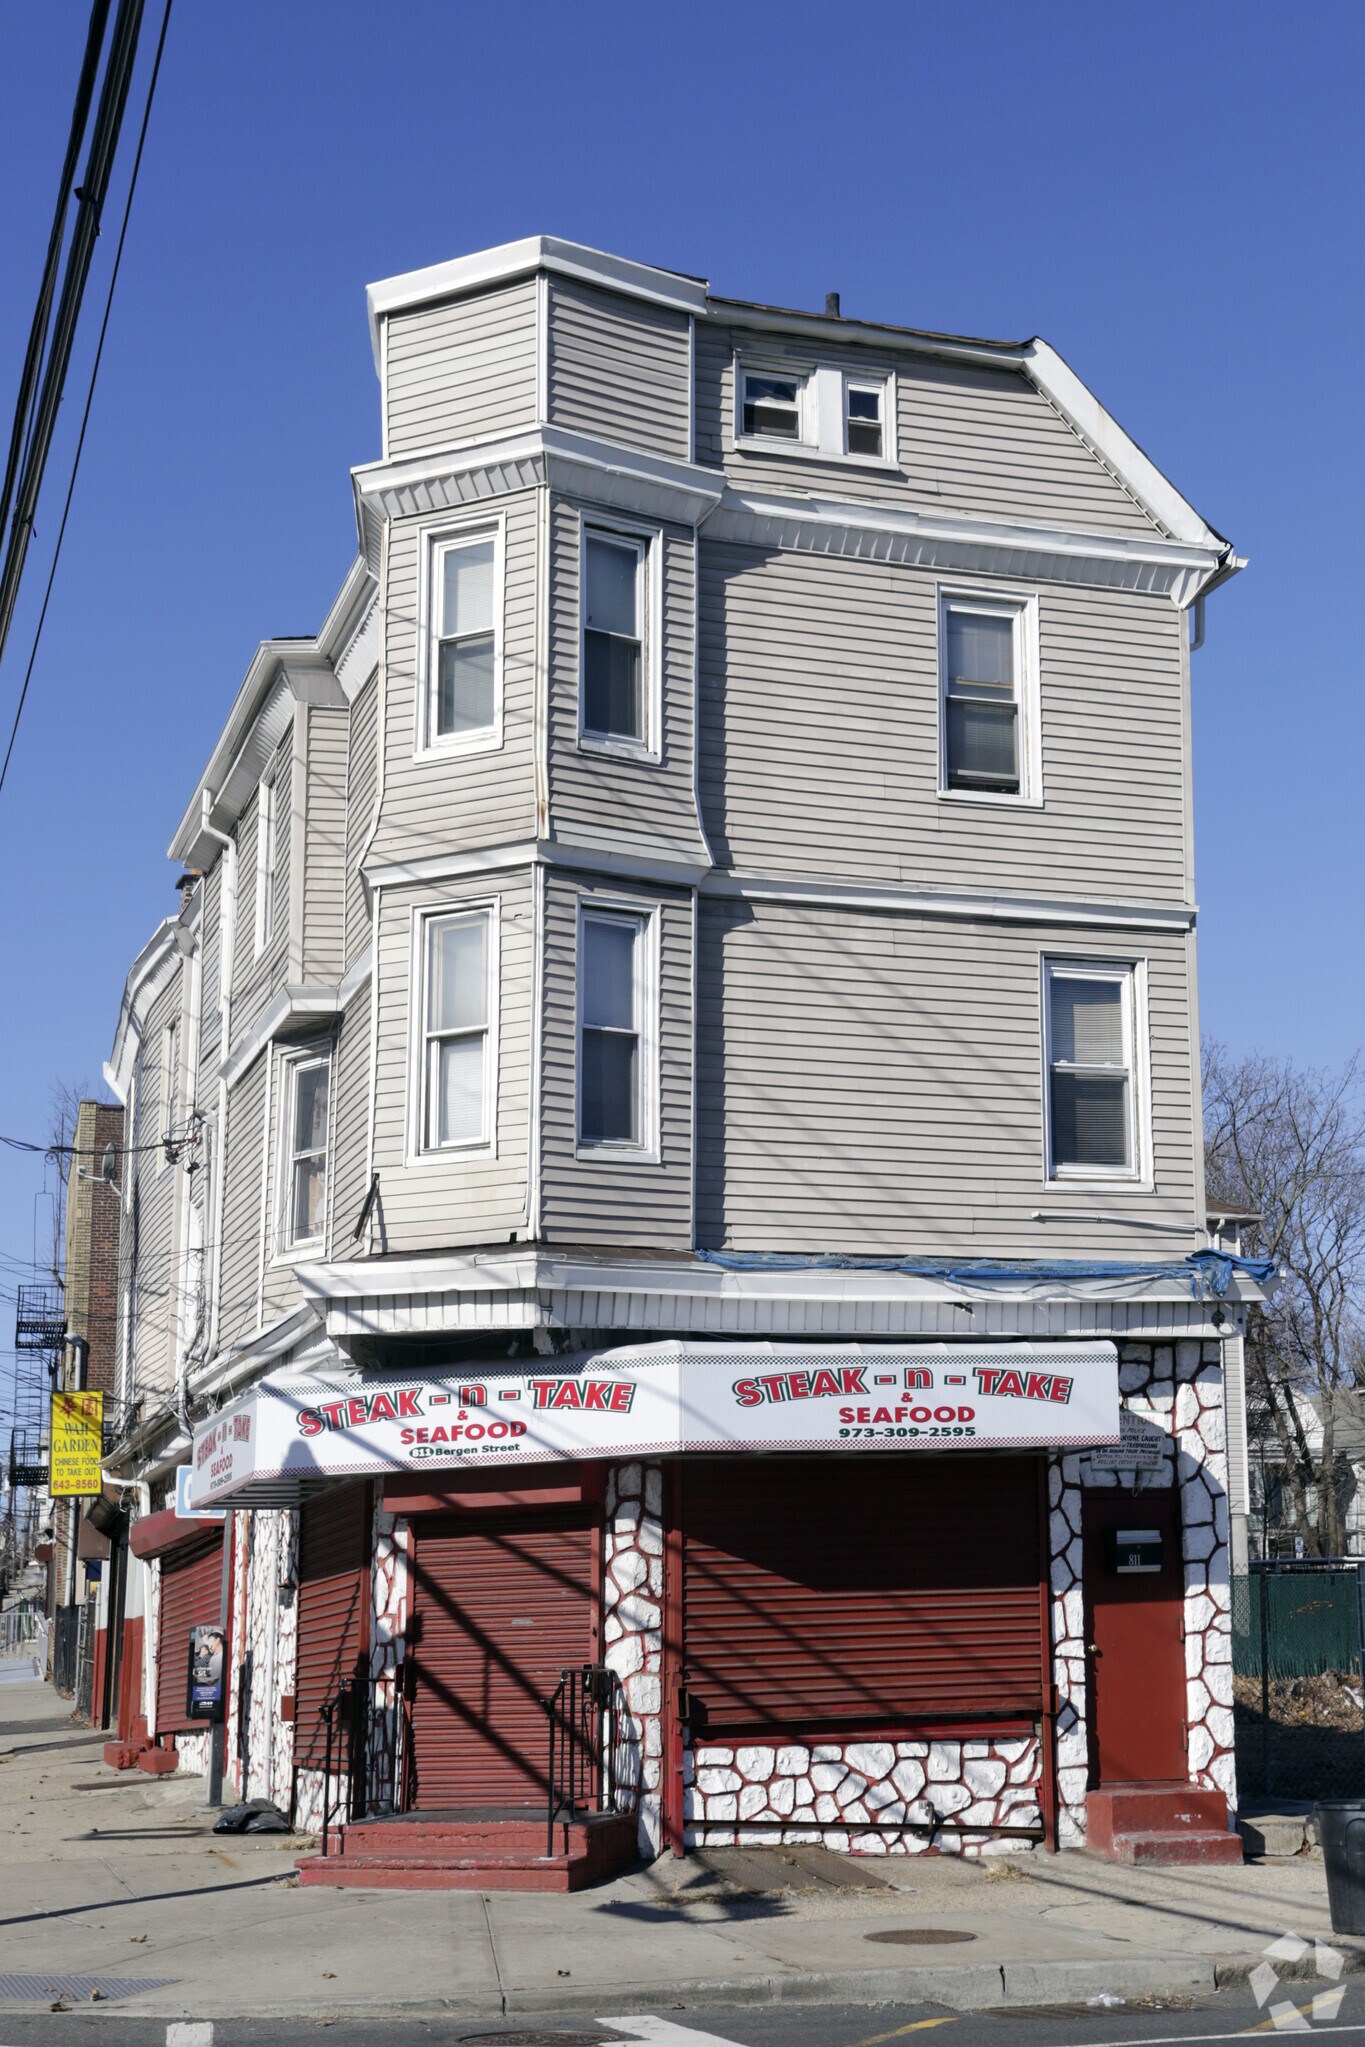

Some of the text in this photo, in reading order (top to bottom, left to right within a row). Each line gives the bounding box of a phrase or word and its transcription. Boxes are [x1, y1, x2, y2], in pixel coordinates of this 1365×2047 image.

[732, 1367, 871, 1407] STEAK
[972, 1367, 1074, 1404] TAKE
[901, 1392, 913, 1403] &
[296, 1387, 425, 1437] STEAK
[528, 1379, 637, 1413] TAKE
[457, 1410, 468, 1421] &
[839, 1406, 975, 1424] SEAFOOD
[65, 1422, 88, 1435] WAH
[400, 1421, 527, 1445] SEAFOOD
[839, 1427, 976, 1438] 973-309-2595
[54, 1438, 99, 1452] GARDEN
[411, 1443, 520, 1458] 811 Bergen Street
[55, 1457, 79, 1466] CHINESE
[211, 1453, 233, 1478] SEAFOOD
[56, 1467, 97, 1476] TO TAKE OUT
[53, 1479, 98, 1490] 643-8560
[1129, 1554, 1141, 1566] 811
